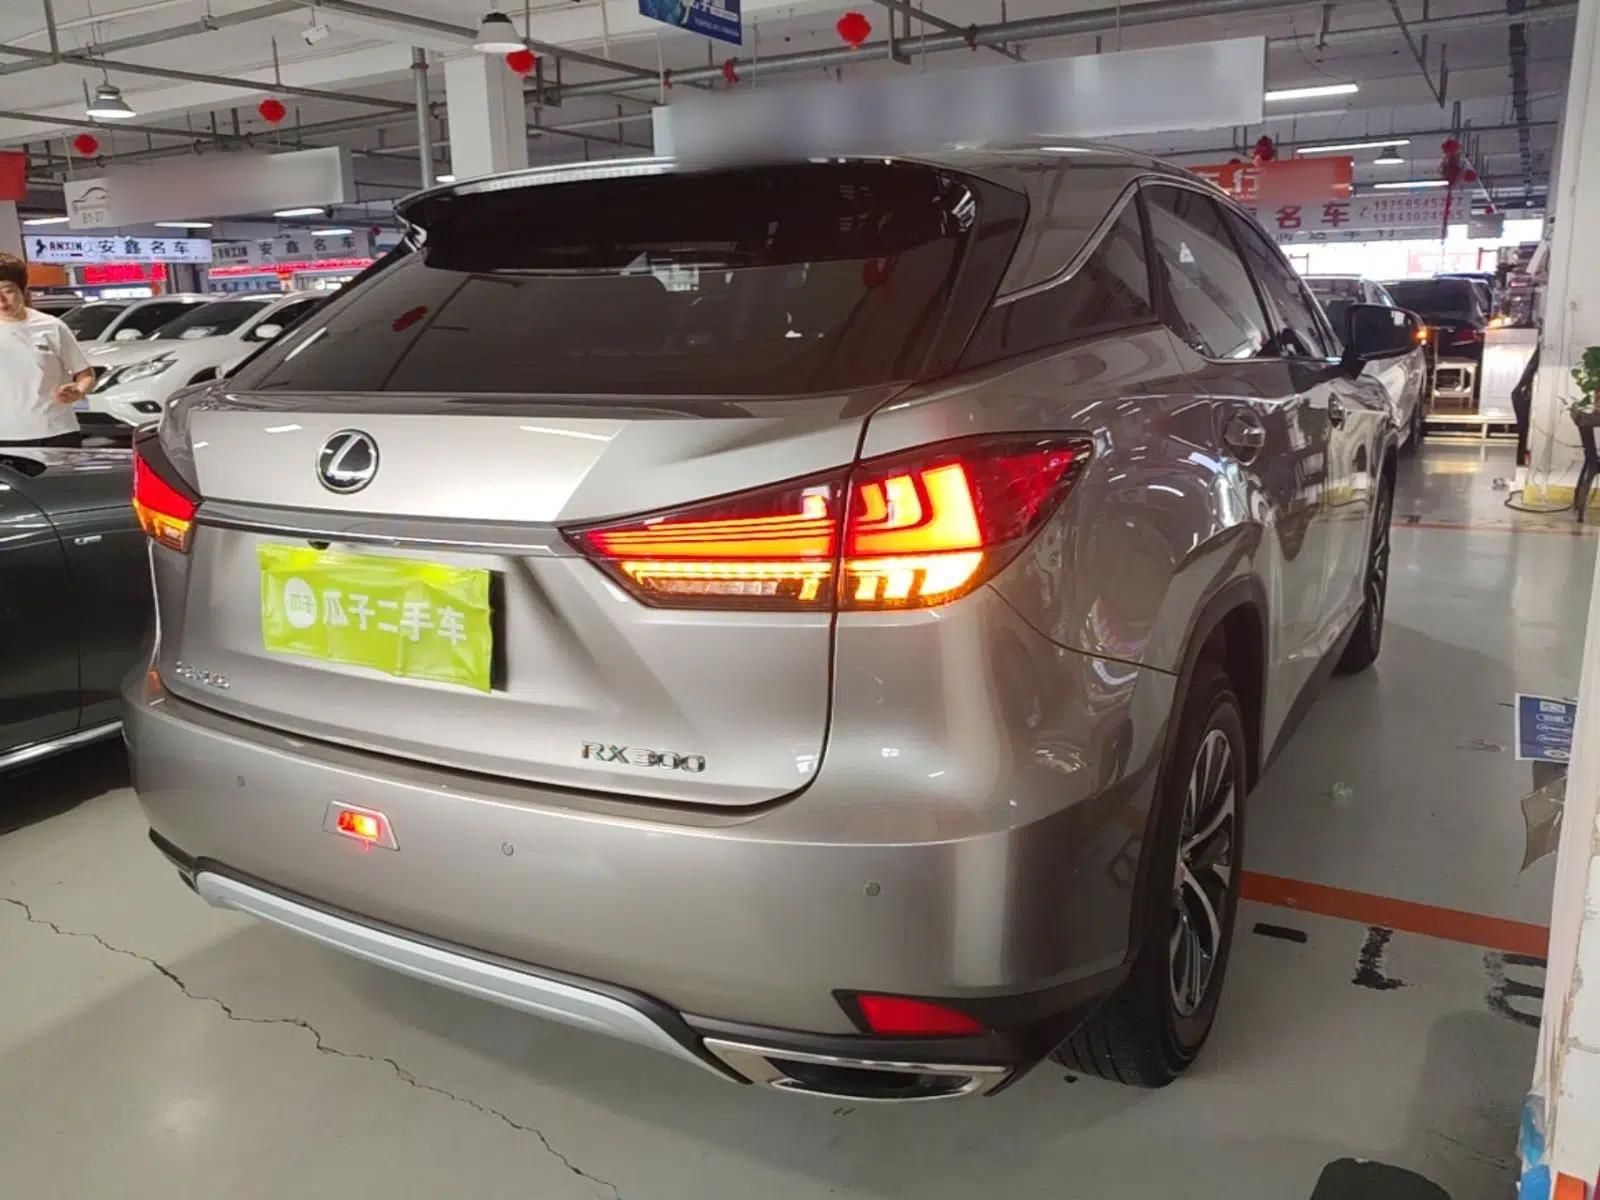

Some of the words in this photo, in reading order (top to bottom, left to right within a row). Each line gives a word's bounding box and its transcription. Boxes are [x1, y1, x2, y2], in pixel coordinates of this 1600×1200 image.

[98, 239, 189, 255] 安鑫名车
[323, 590, 467, 645] 瓜子二手车
